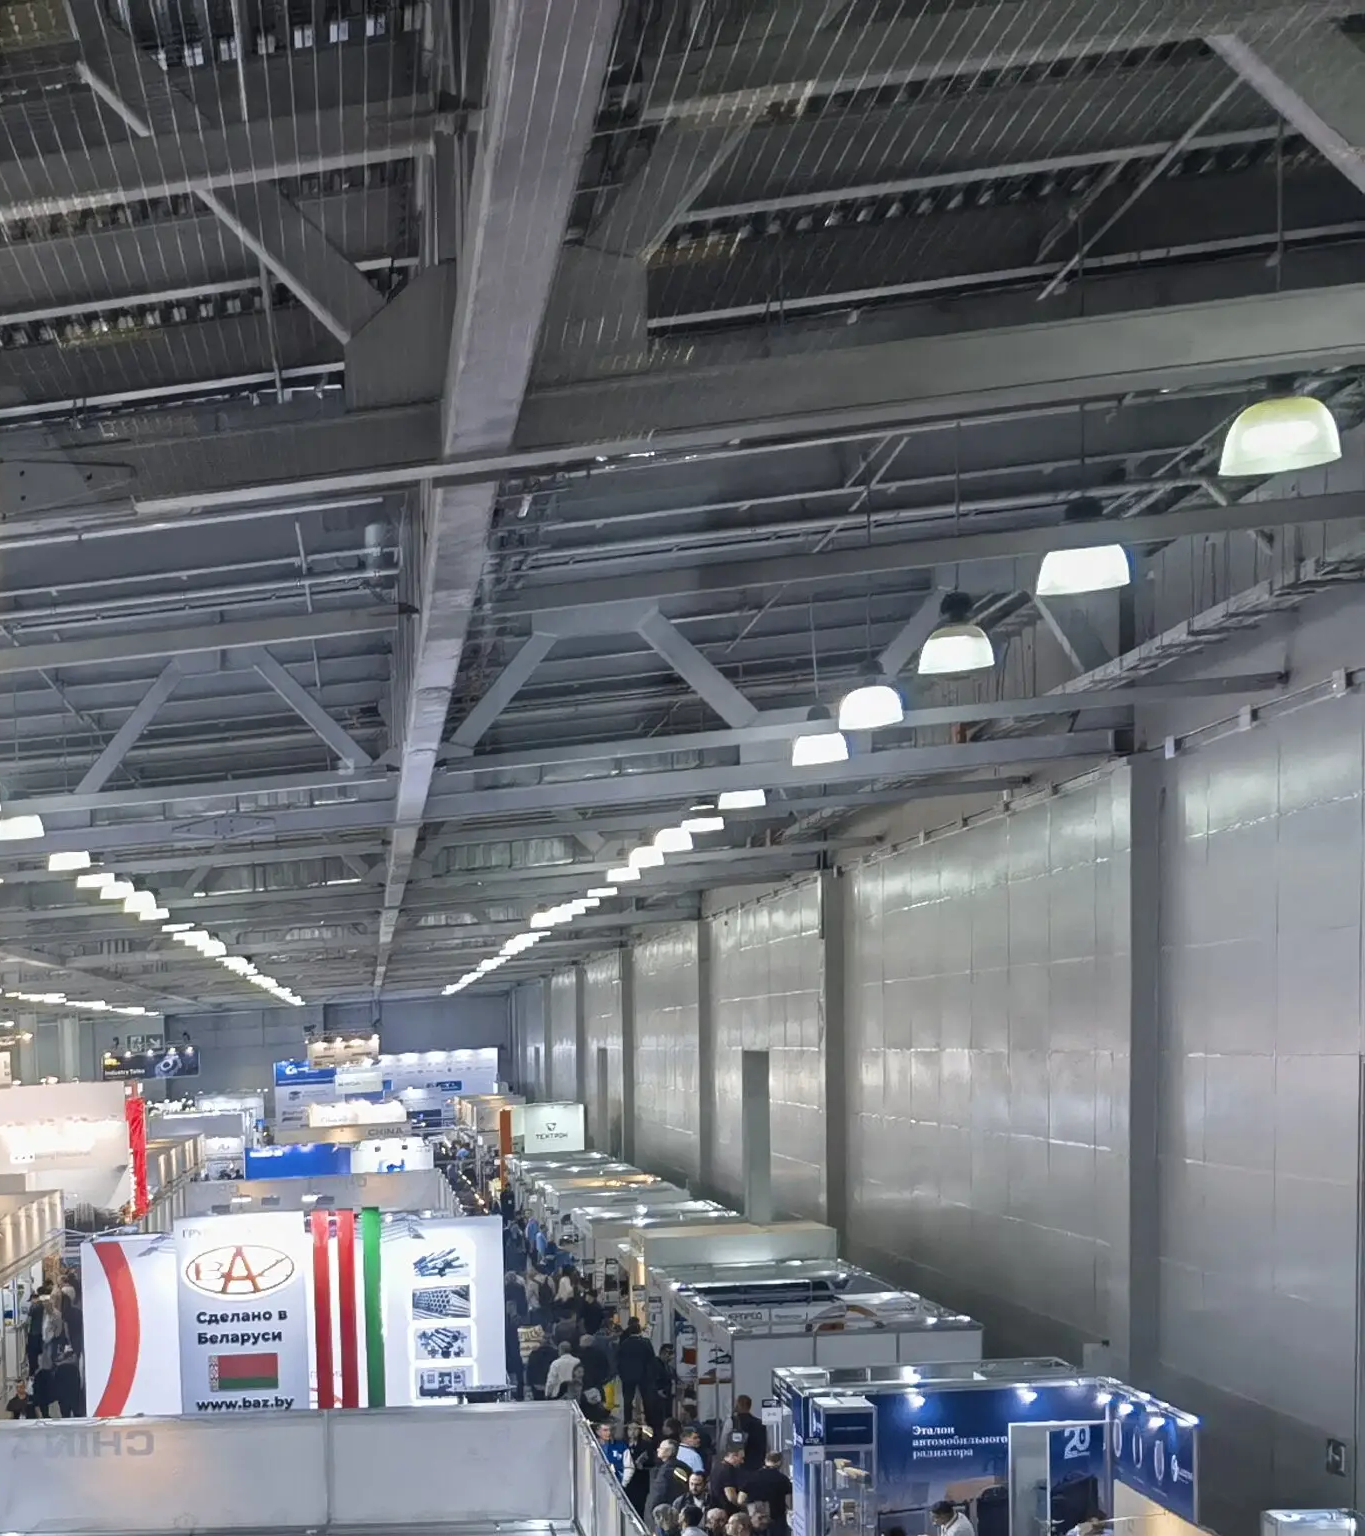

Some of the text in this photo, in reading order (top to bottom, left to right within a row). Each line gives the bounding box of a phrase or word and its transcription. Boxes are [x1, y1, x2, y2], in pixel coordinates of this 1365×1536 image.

[197, 1310, 288, 1325] Сделано в
[198, 1330, 282, 1345] Беларуси
[197, 1396, 294, 1411] www.baz.by
[912, 1426, 955, 1436] Эталон
[912, 1435, 1008, 1448] автомобильного
[912, 1448, 974, 1460] радиатора
